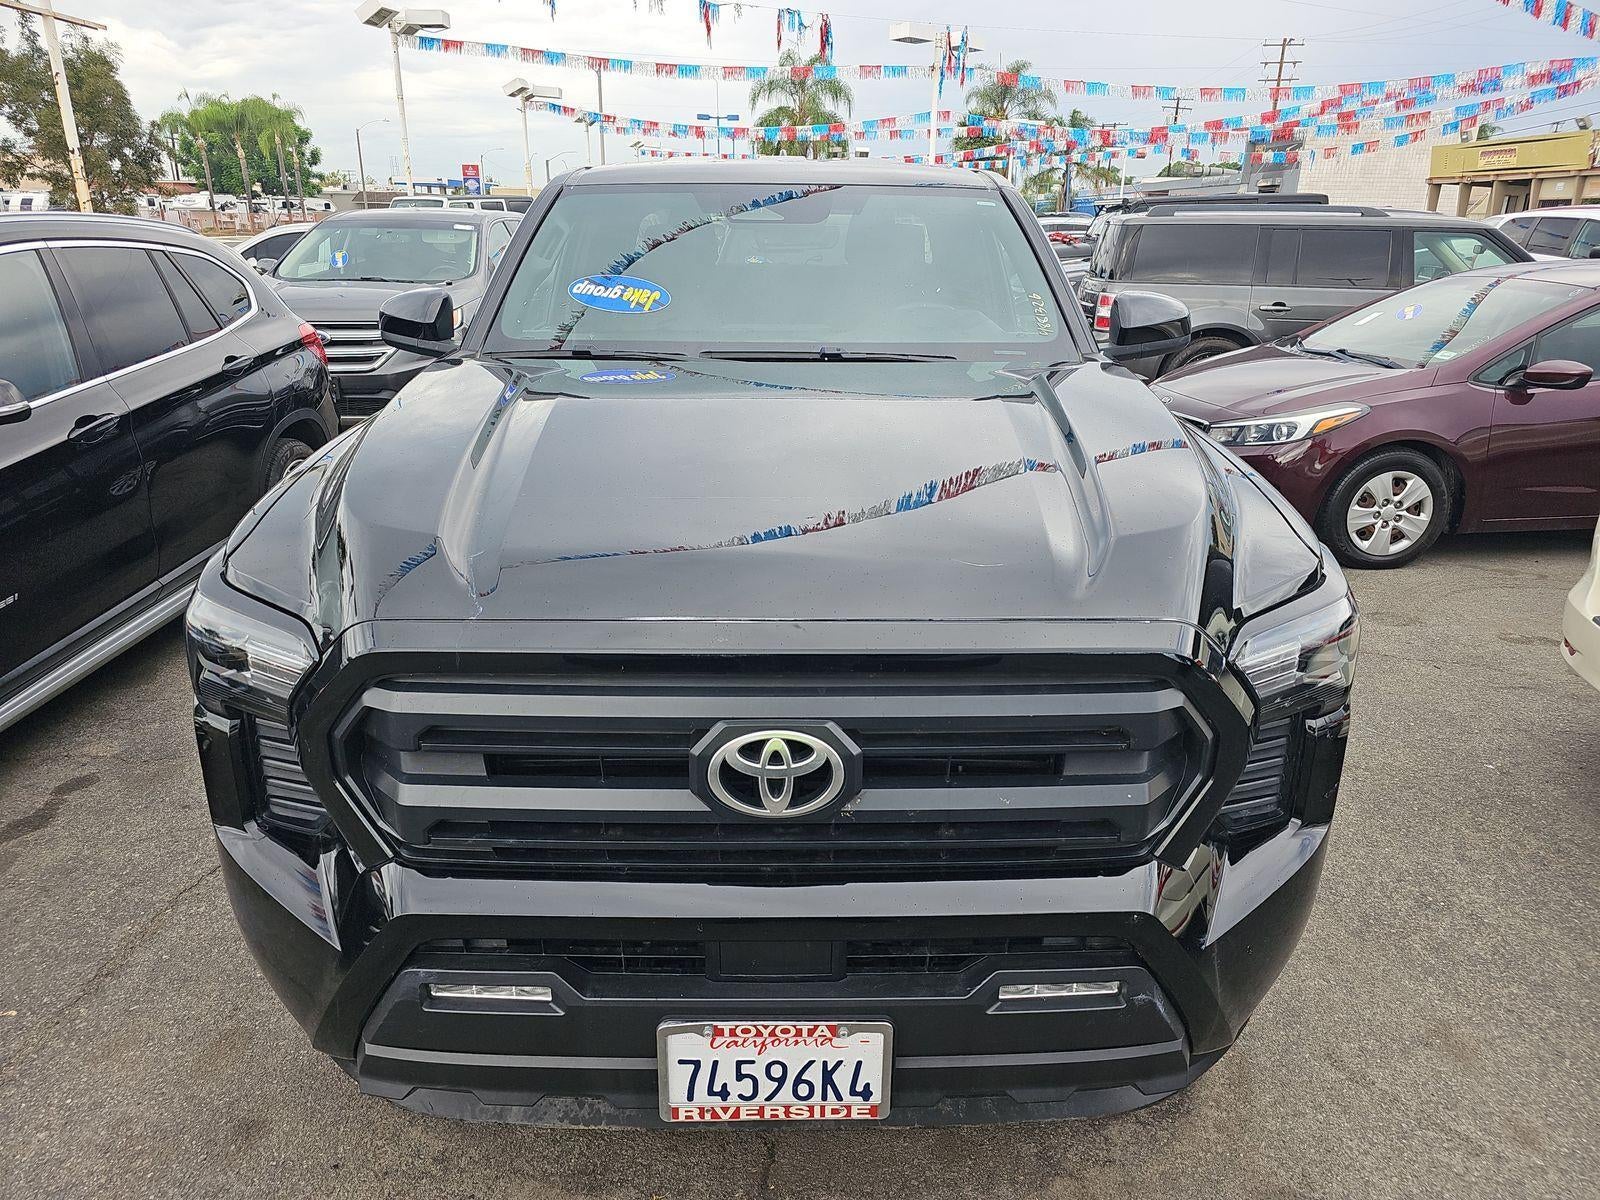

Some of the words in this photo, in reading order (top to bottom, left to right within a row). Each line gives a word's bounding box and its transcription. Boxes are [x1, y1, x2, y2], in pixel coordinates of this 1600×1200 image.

[572, 280, 624, 299] group
[622, 287, 661, 311] Jake
[717, 1025, 833, 1038] TOYOTA
[709, 1037, 849, 1056] California
[677, 1059, 874, 1102] 74596K4
[678, 1105, 873, 1121] RIVERSIDE
